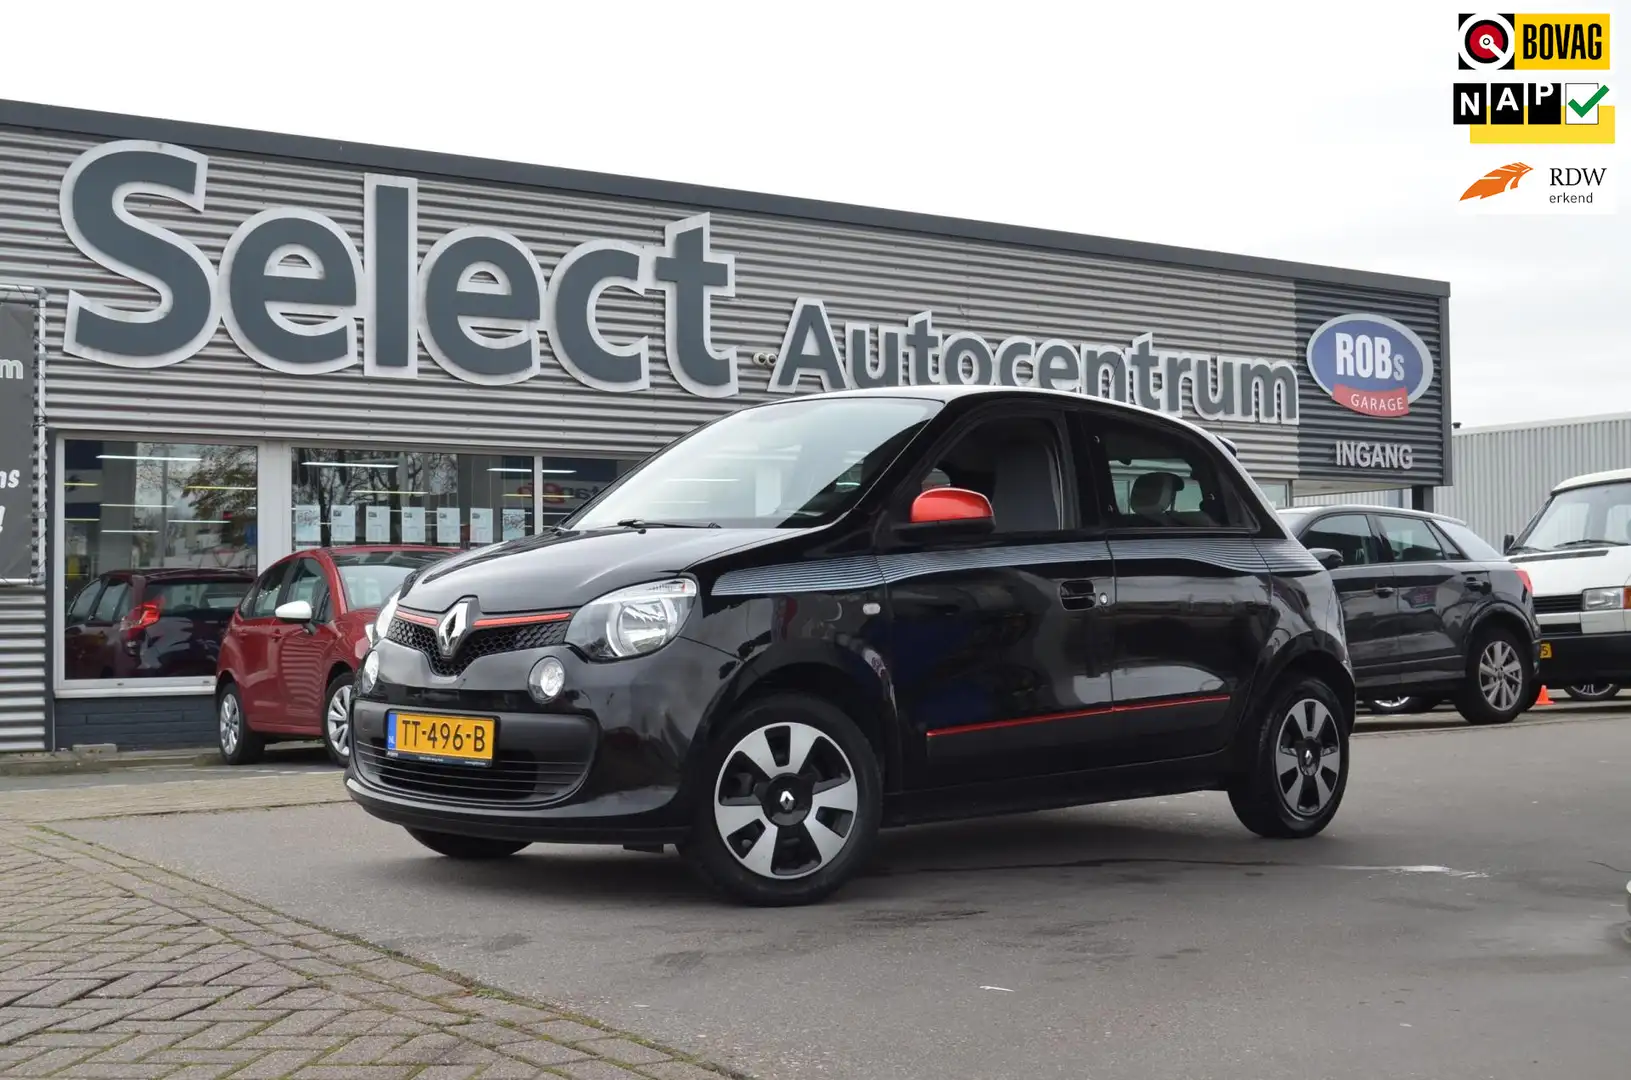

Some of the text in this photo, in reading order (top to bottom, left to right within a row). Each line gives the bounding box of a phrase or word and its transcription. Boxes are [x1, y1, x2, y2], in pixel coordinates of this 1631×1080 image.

[60, 139, 1299, 424] Select Autocentrum
[1350, 393, 1404, 411] GARAGE
[1335, 440, 1414, 470] INGANG
[402, 720, 485, 752] TT-496-B
